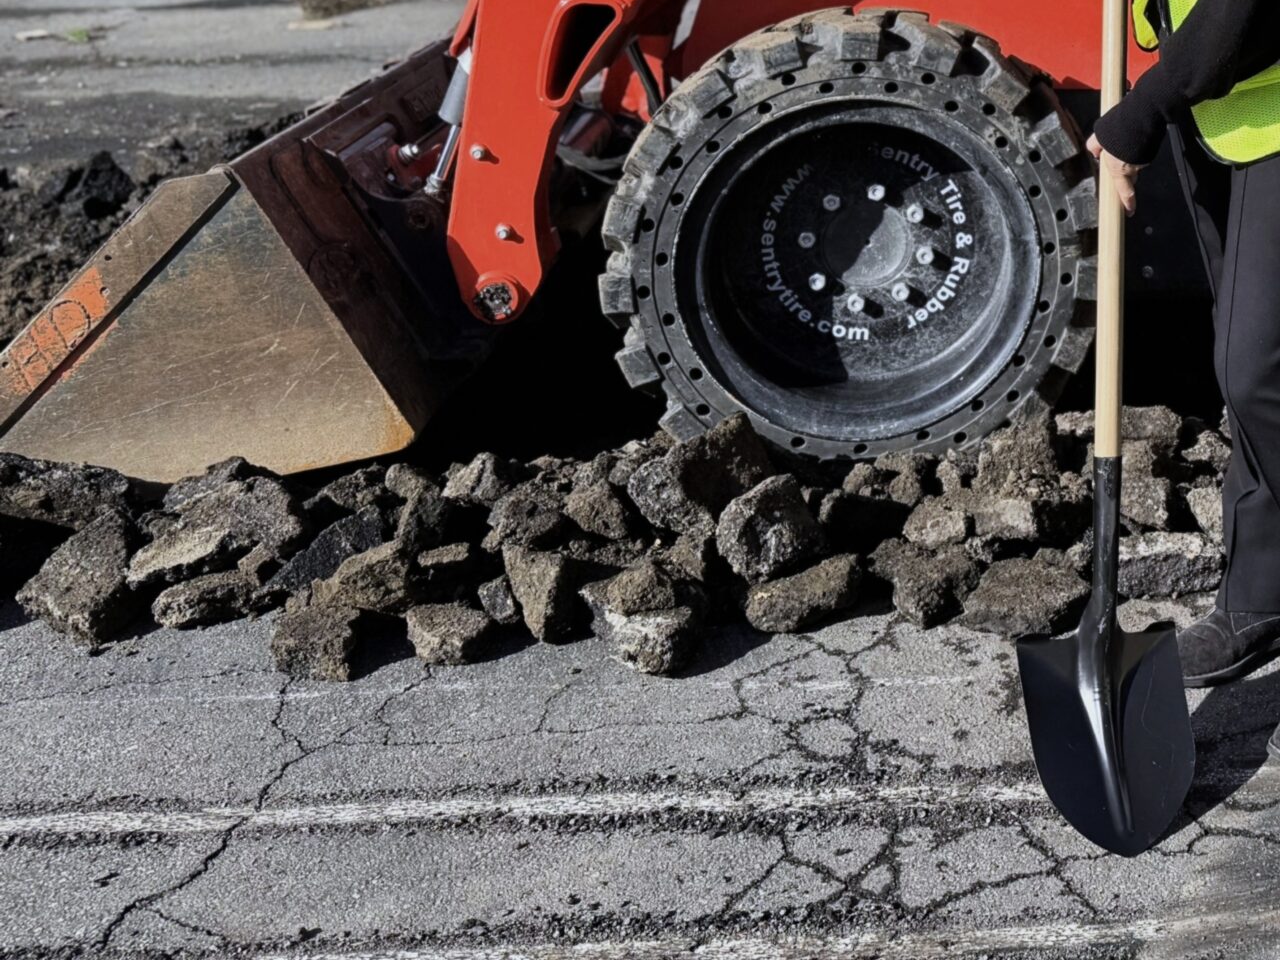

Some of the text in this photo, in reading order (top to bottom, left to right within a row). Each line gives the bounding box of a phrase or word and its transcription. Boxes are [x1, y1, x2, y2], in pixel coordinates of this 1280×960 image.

[939, 178, 967, 225] Tire
[761, 162, 870, 341] www.sentrytire.com
[955, 231, 974, 249] &
[906, 255, 970, 329] Rubber
